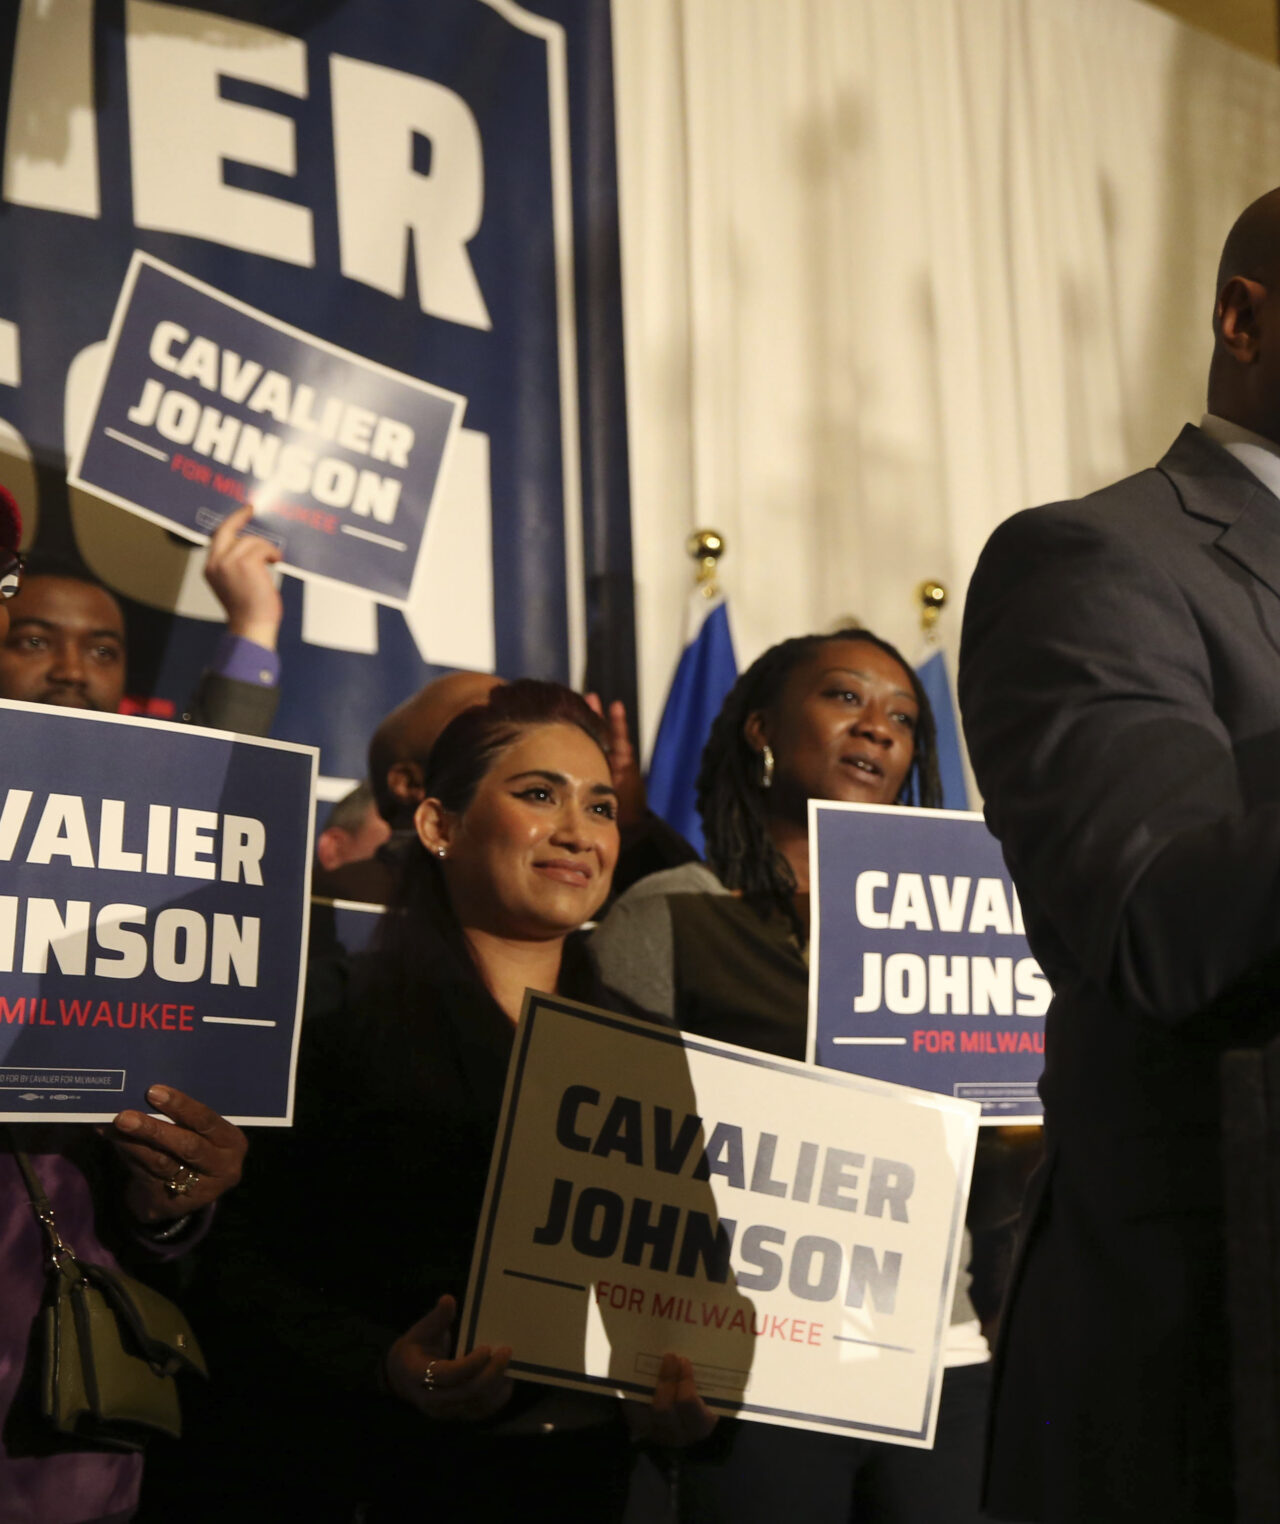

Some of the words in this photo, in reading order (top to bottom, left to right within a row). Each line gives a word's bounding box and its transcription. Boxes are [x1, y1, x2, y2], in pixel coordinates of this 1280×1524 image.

[149, 320, 415, 468] CAVALIER
[127, 378, 402, 525] JOHNSON
[170, 453, 213, 488] FOR
[0, 896, 261, 988] NSON
[0, 996, 195, 1031] MILWAUKEE
[853, 952, 1053, 1017] JOHNS
[913, 1030, 955, 1053] FOR
[555, 1085, 917, 1224] CAVALIER
[533, 1178, 903, 1314] JOHNSON
[596, 1280, 645, 1314] FOR
[652, 1292, 824, 1347] MILWAUKEE
